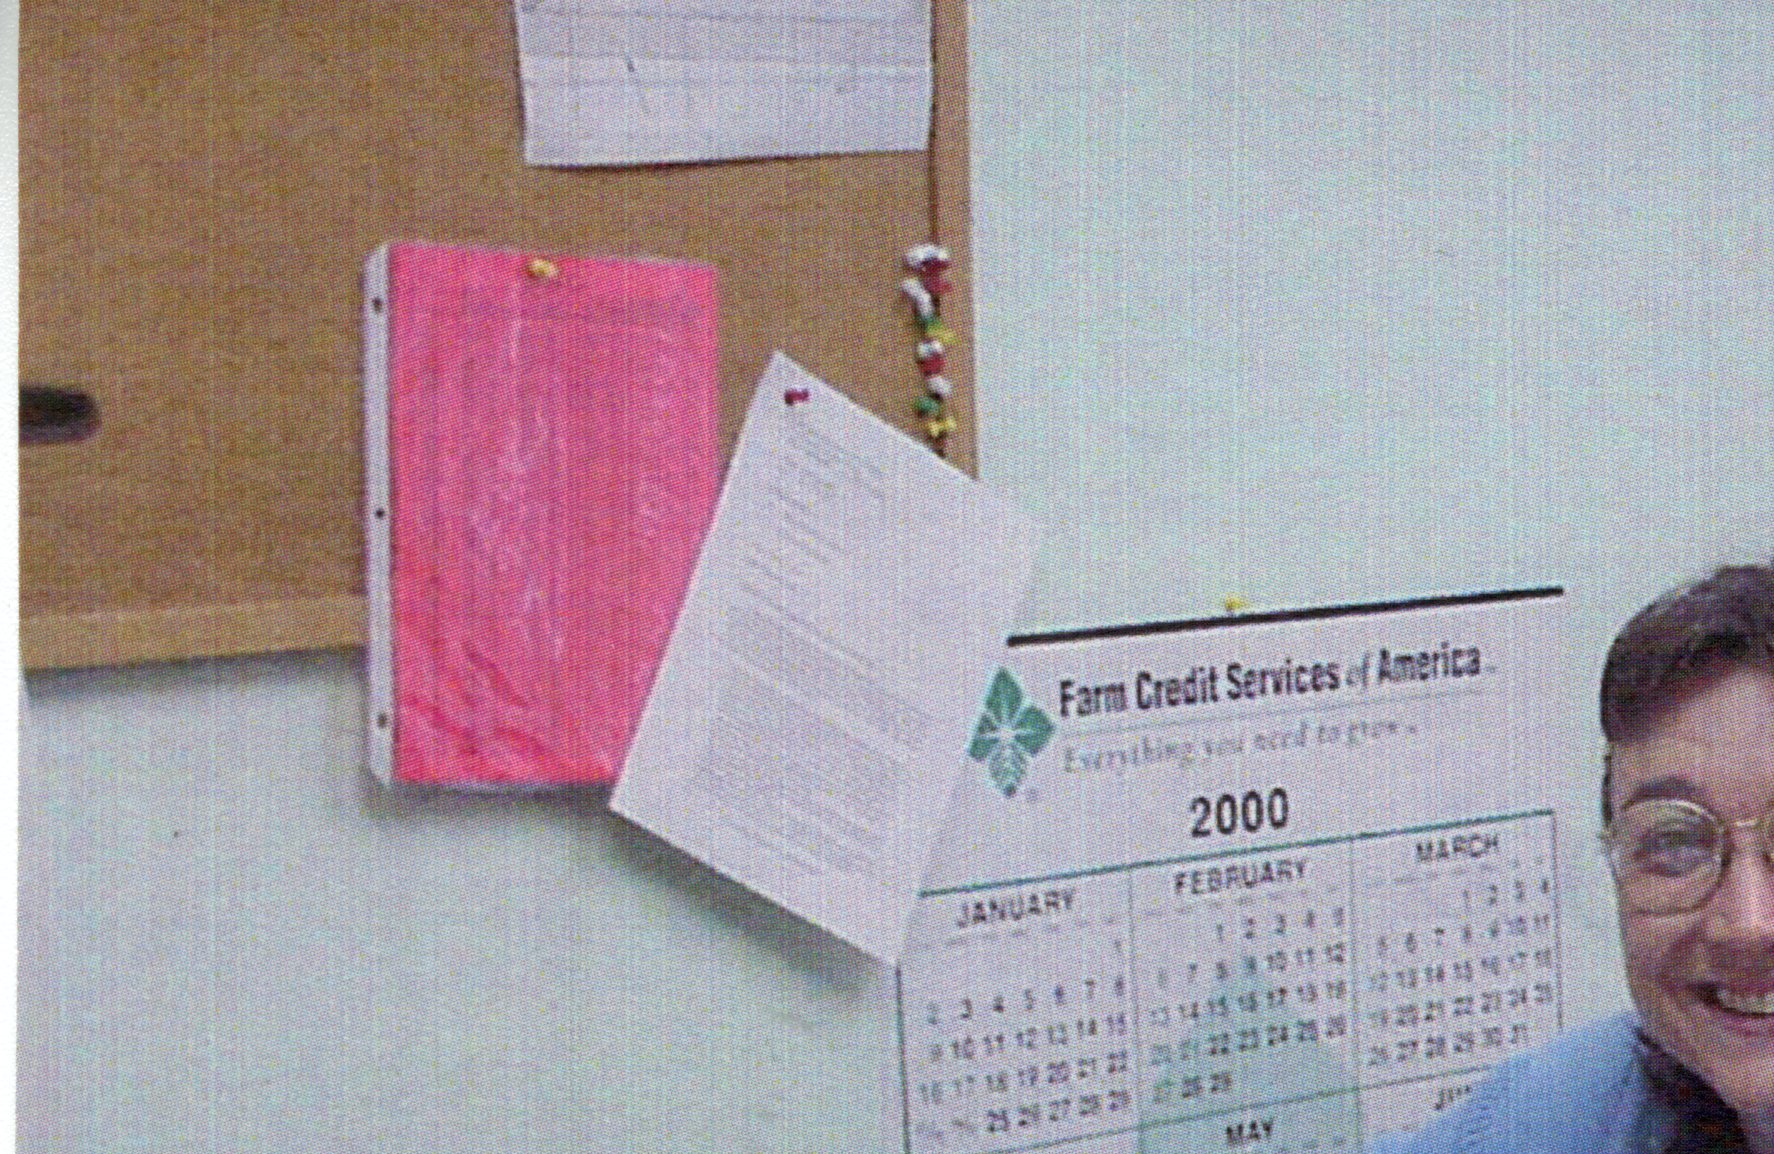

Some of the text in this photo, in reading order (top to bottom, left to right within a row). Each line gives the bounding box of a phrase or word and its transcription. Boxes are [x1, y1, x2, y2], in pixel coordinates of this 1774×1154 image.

[1058, 644, 1481, 717] Farm Credit Services of America
[1064, 738, 1194, 773] Everything
[1203, 729, 1244, 756] you
[1252, 723, 1308, 752] need
[1317, 715, 1339, 742] to
[1189, 787, 1289, 838] 2000
[1416, 834, 1499, 864] MARCH
[1175, 858, 1308, 896] FEBRUARY
[1488, 883, 1498, 905] 2
[1514, 880, 1524, 902] 3
[956, 889, 1075, 929] JANUARY
[1245, 917, 1255, 939] 2
[1276, 914, 1286, 935] 3
[1188, 963, 1197, 983] 7
[1325, 942, 1344, 963] 12
[960, 997, 973, 1020] 3
[1084, 977, 1096, 999] 7
[1454, 995, 1472, 1016] 22
[952, 1036, 974, 1060] 10
[983, 1034, 1004, 1055] 11
[1016, 1027, 1037, 1050] 12
[1208, 1032, 1229, 1056] 22
[1267, 1025, 1288, 1047] 24
[1434, 1086, 1472, 1110] JU
[1225, 1117, 1274, 1146] MAY
